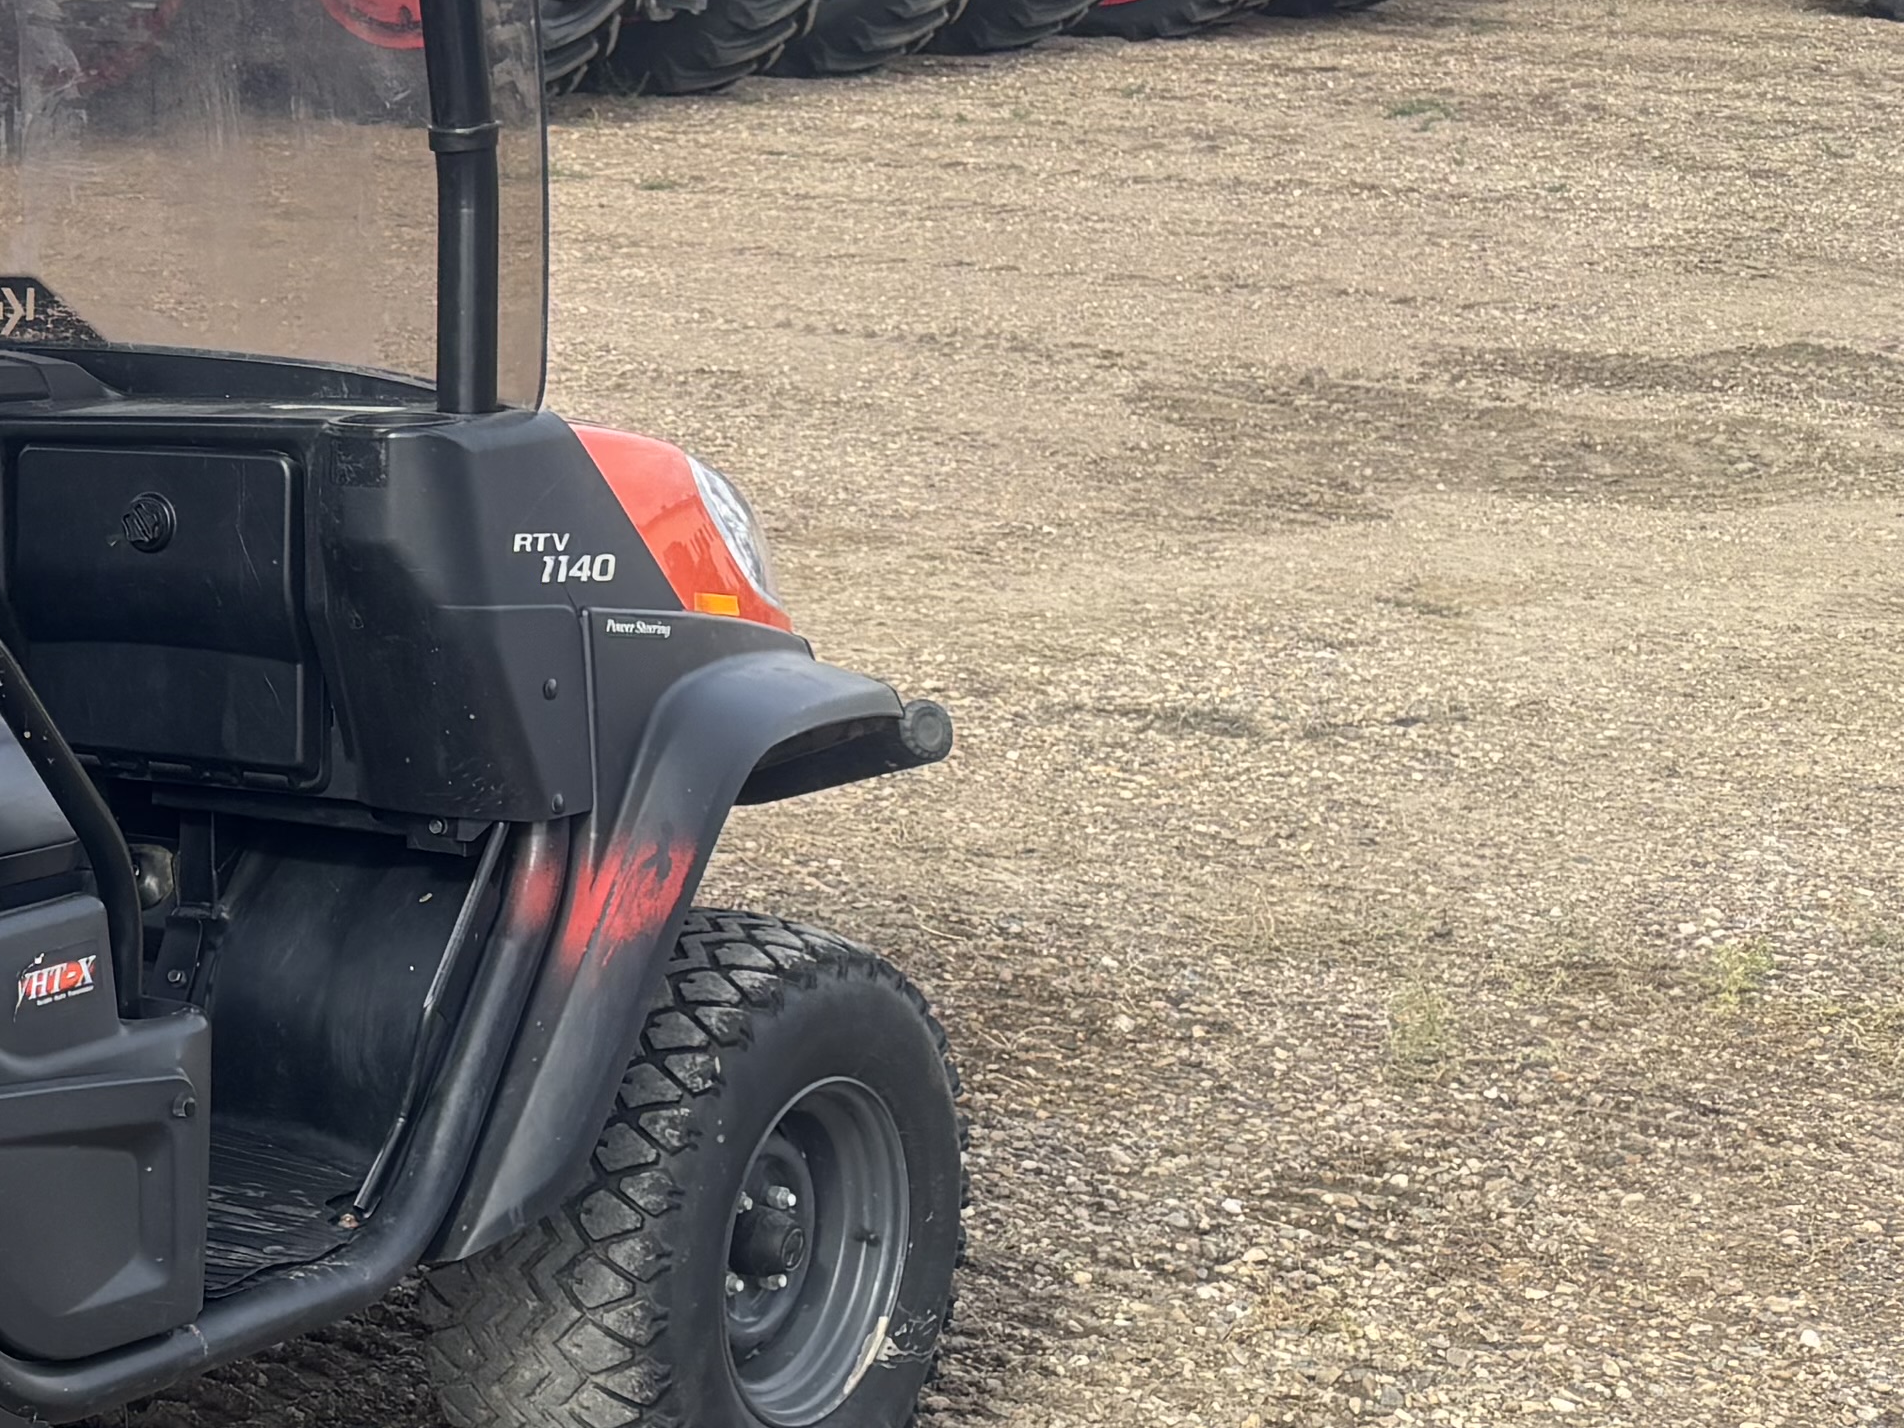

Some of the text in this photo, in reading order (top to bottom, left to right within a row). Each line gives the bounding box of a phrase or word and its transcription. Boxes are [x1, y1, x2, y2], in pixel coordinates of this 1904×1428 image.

[513, 533, 570, 552] RTV
[541, 554, 616, 583] 1140
[606, 619, 671, 639] Power Steering
